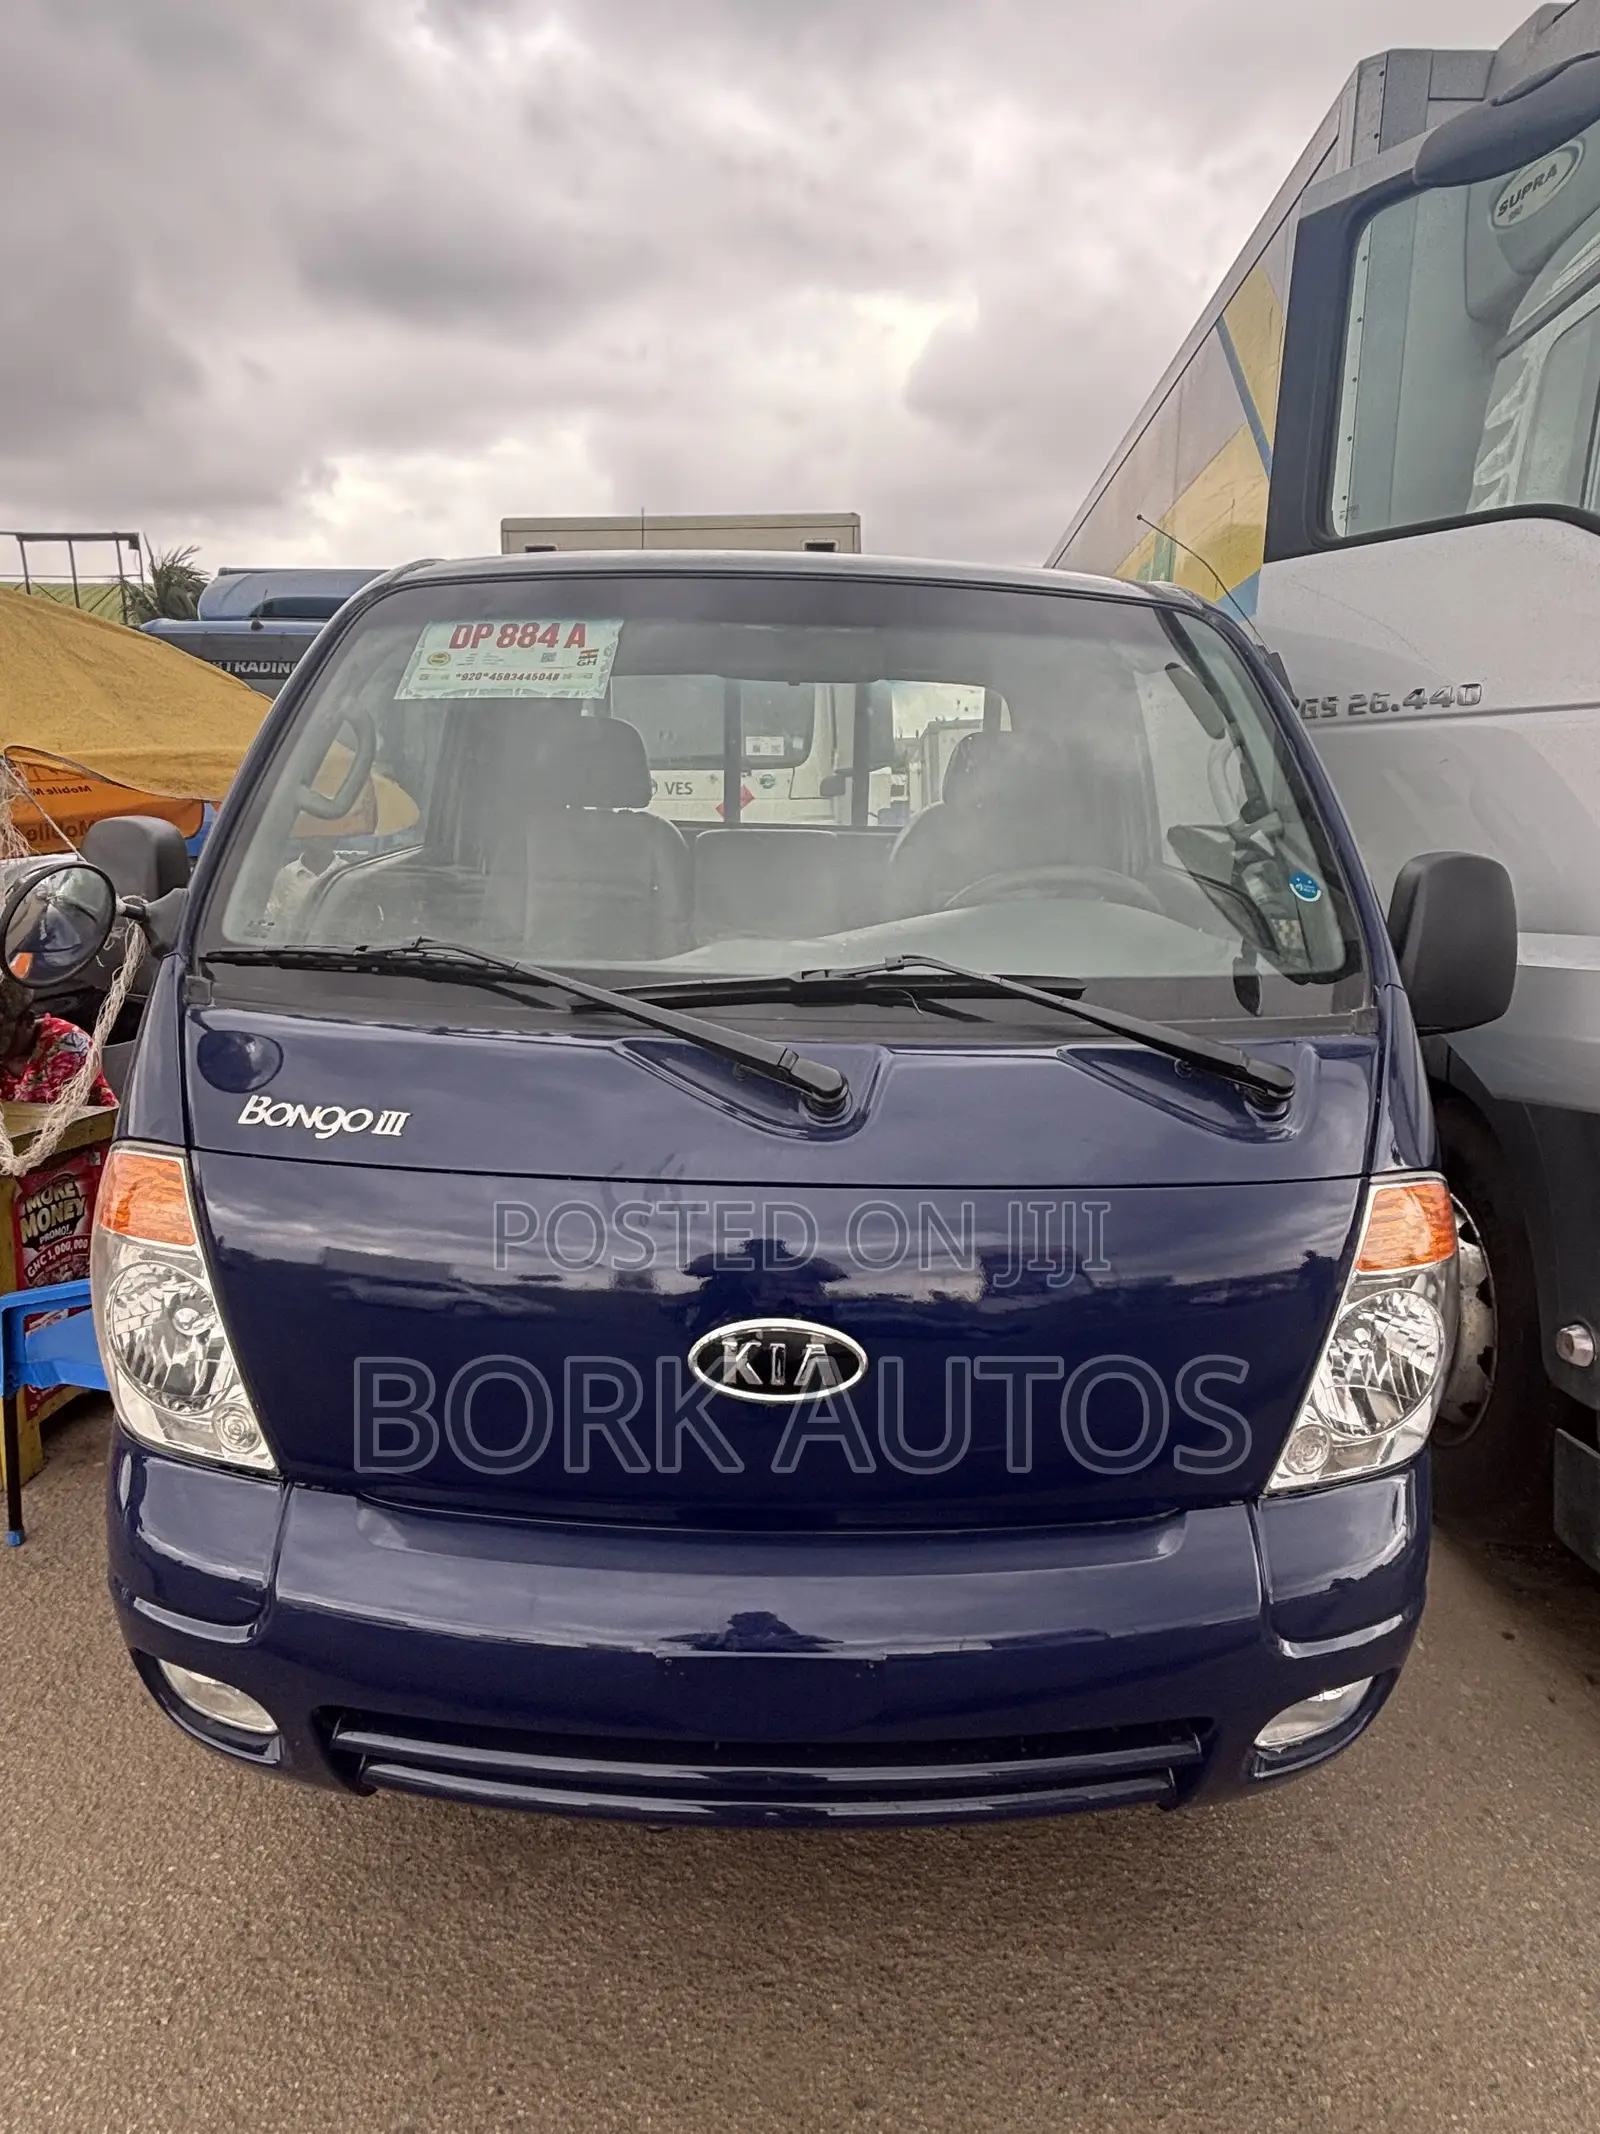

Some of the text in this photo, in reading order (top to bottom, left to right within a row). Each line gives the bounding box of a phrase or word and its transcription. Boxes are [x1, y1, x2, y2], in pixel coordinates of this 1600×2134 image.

[1497, 163, 1558, 218] SUPRA
[449, 622, 586, 648] DP 884 A
[1348, 682, 1482, 716] 26.440
[664, 781, 693, 795] VES
[371, 1110, 411, 1136] III
[21, 1197, 86, 1243] MONEY
[722, 1342, 837, 1386] KIA
